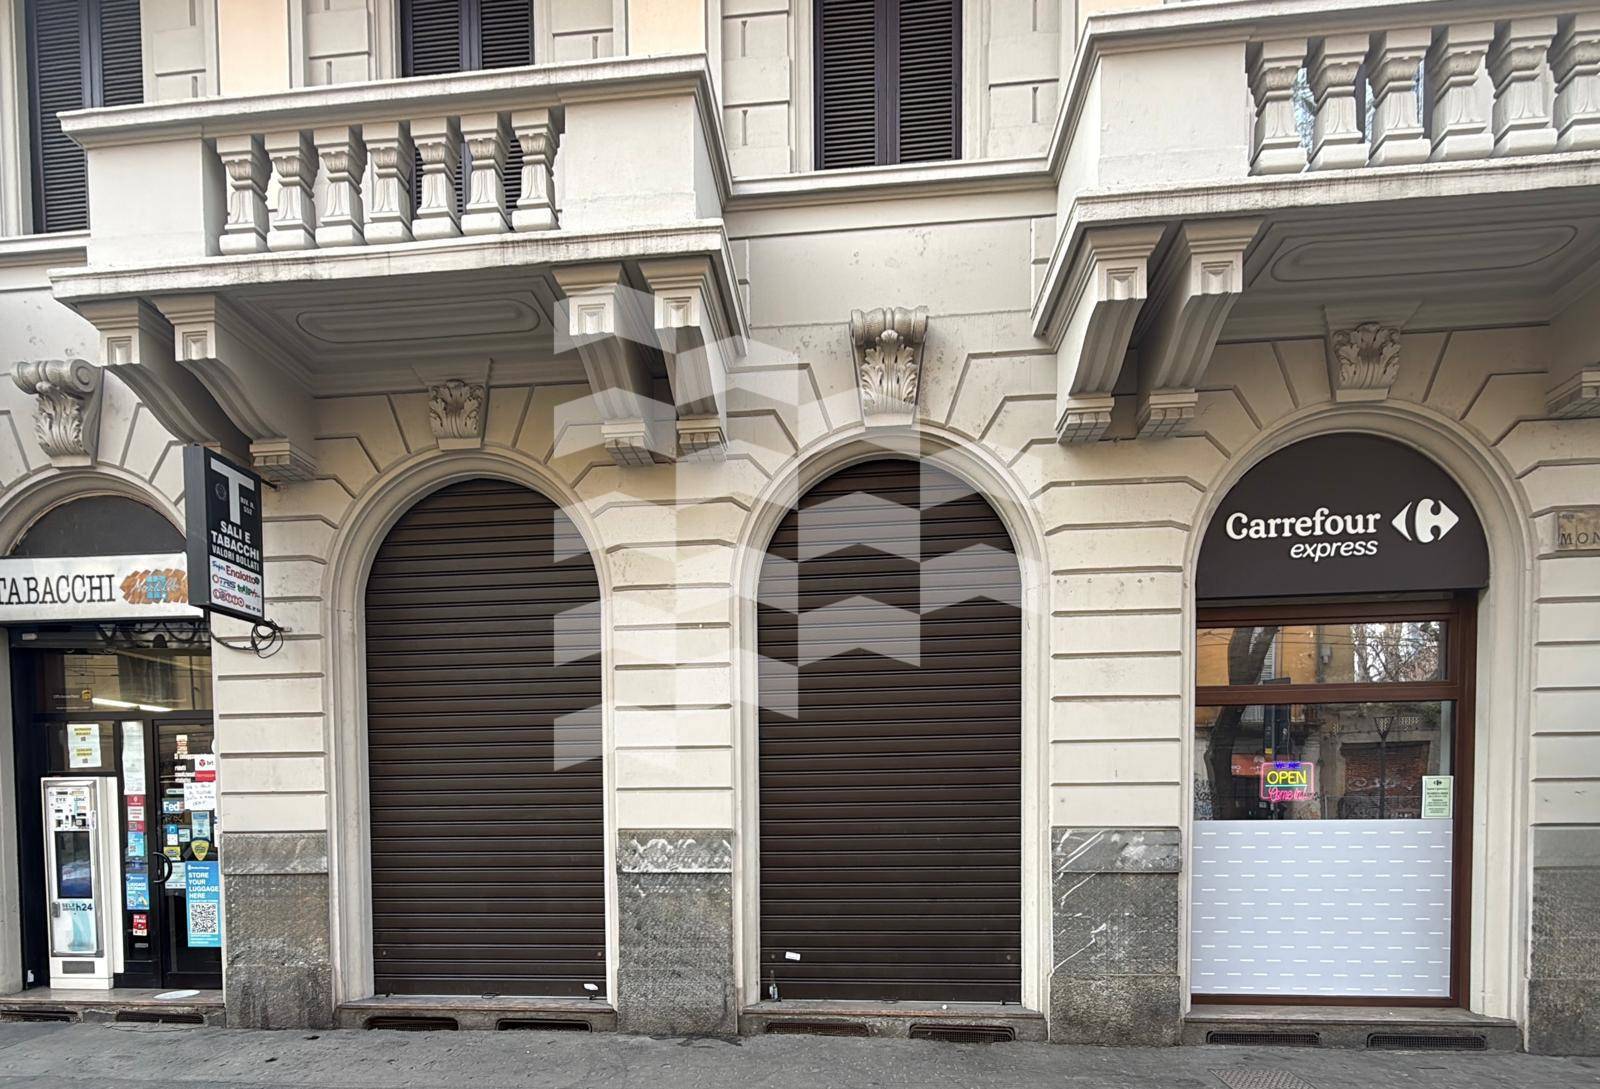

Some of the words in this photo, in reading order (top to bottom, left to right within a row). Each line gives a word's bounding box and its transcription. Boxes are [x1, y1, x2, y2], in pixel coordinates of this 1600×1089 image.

[211, 457, 255, 526] T
[220, 520, 242, 539] SALI
[244, 531, 251, 544] E
[1225, 507, 1381, 540] Carrefour
[210, 530, 260, 561] TABACCHI
[212, 544, 235, 561] VALORI
[236, 555, 260, 572] BOLLATI
[1289, 540, 1379, 562] express
[1266, 770, 1307, 785] OPEN
[163, 801, 185, 812] FedE
